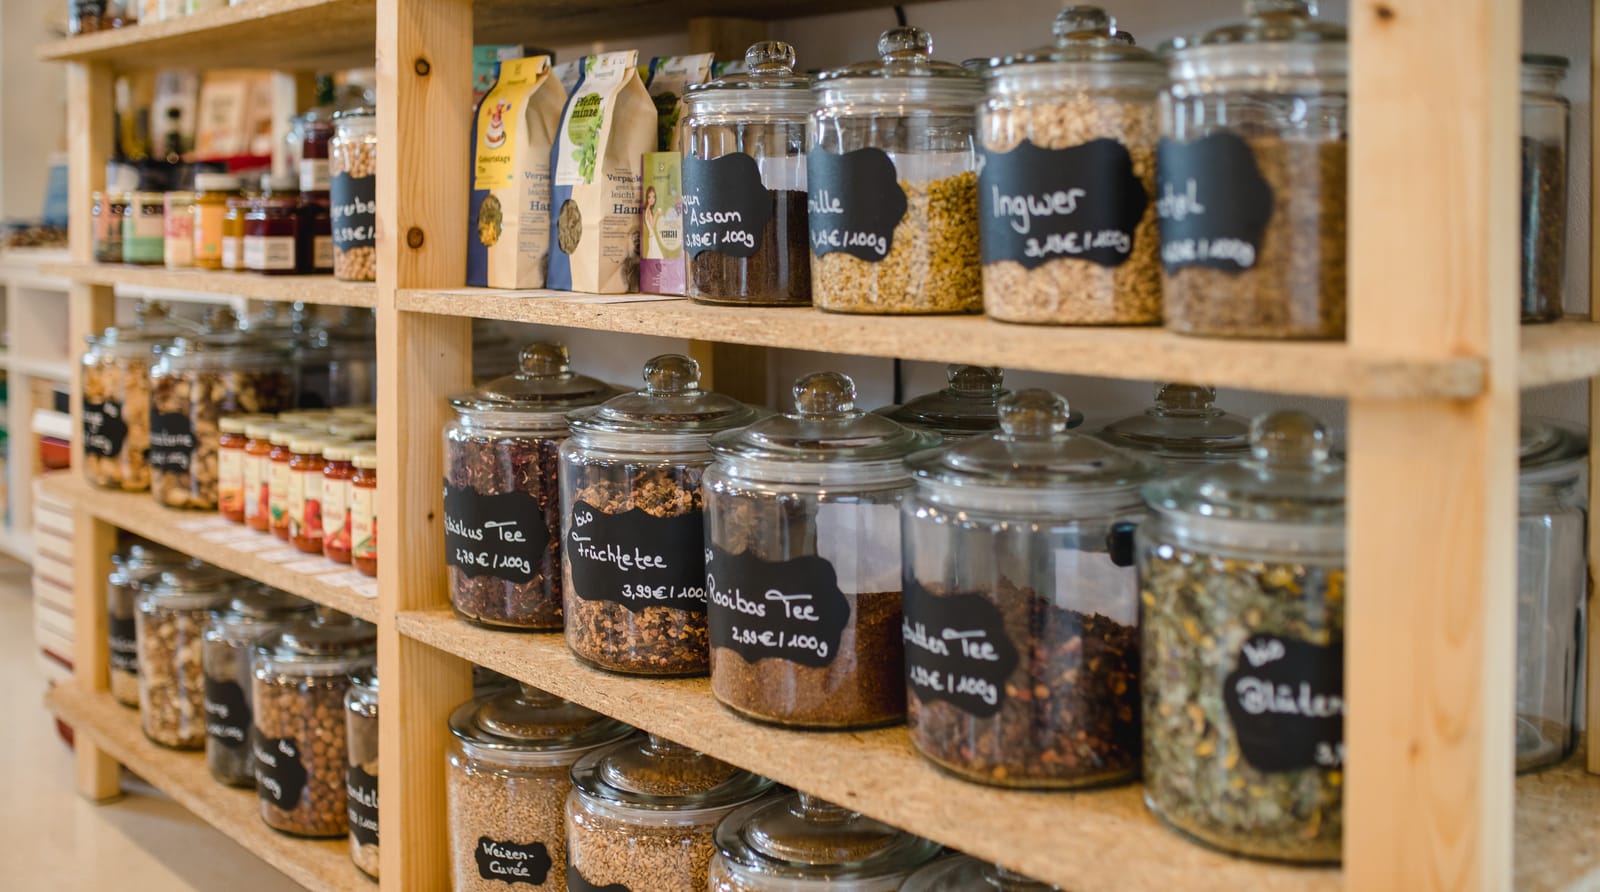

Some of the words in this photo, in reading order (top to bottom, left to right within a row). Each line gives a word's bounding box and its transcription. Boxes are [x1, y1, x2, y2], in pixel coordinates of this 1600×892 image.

[690, 207, 742, 227] Assam
[991, 184, 1086, 235] Ingwer
[484, 520, 527, 542] Tee
[574, 511, 594, 527] bio
[706, 573, 767, 618] Rooibos
[764, 589, 820, 621] Tee
[942, 628, 1000, 661] Tee
